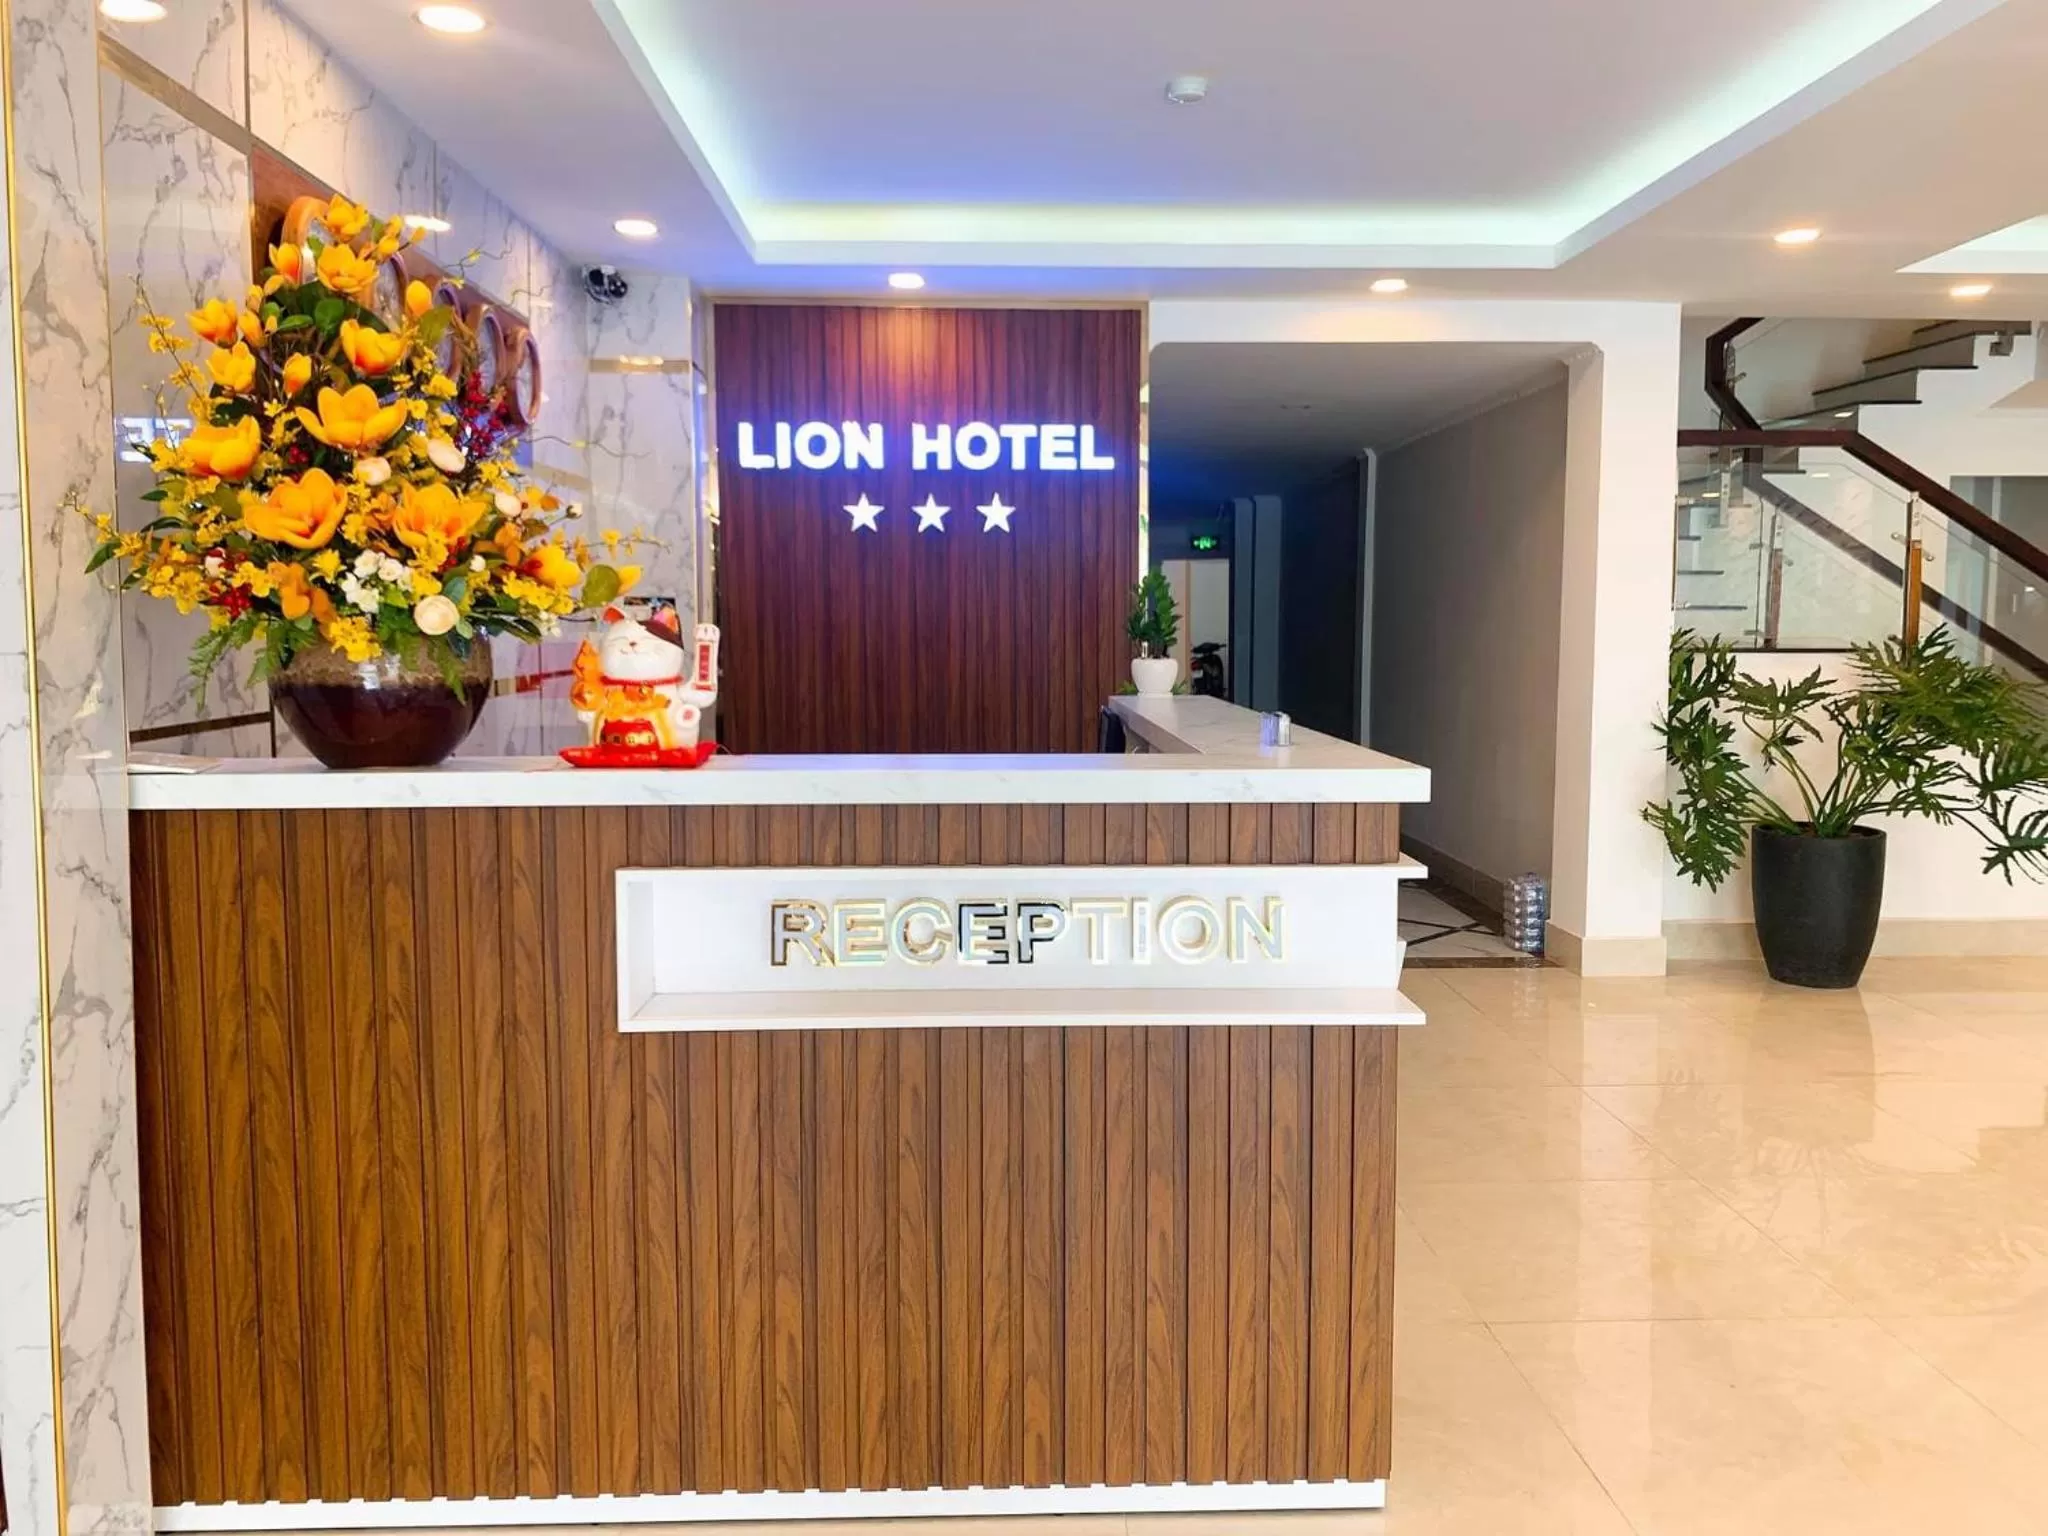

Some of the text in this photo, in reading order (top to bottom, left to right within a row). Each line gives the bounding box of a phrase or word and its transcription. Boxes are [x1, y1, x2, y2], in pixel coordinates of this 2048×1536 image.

[738, 421, 1115, 470] LION HOTEL
[770, 896, 1289, 967] RECEPTION
